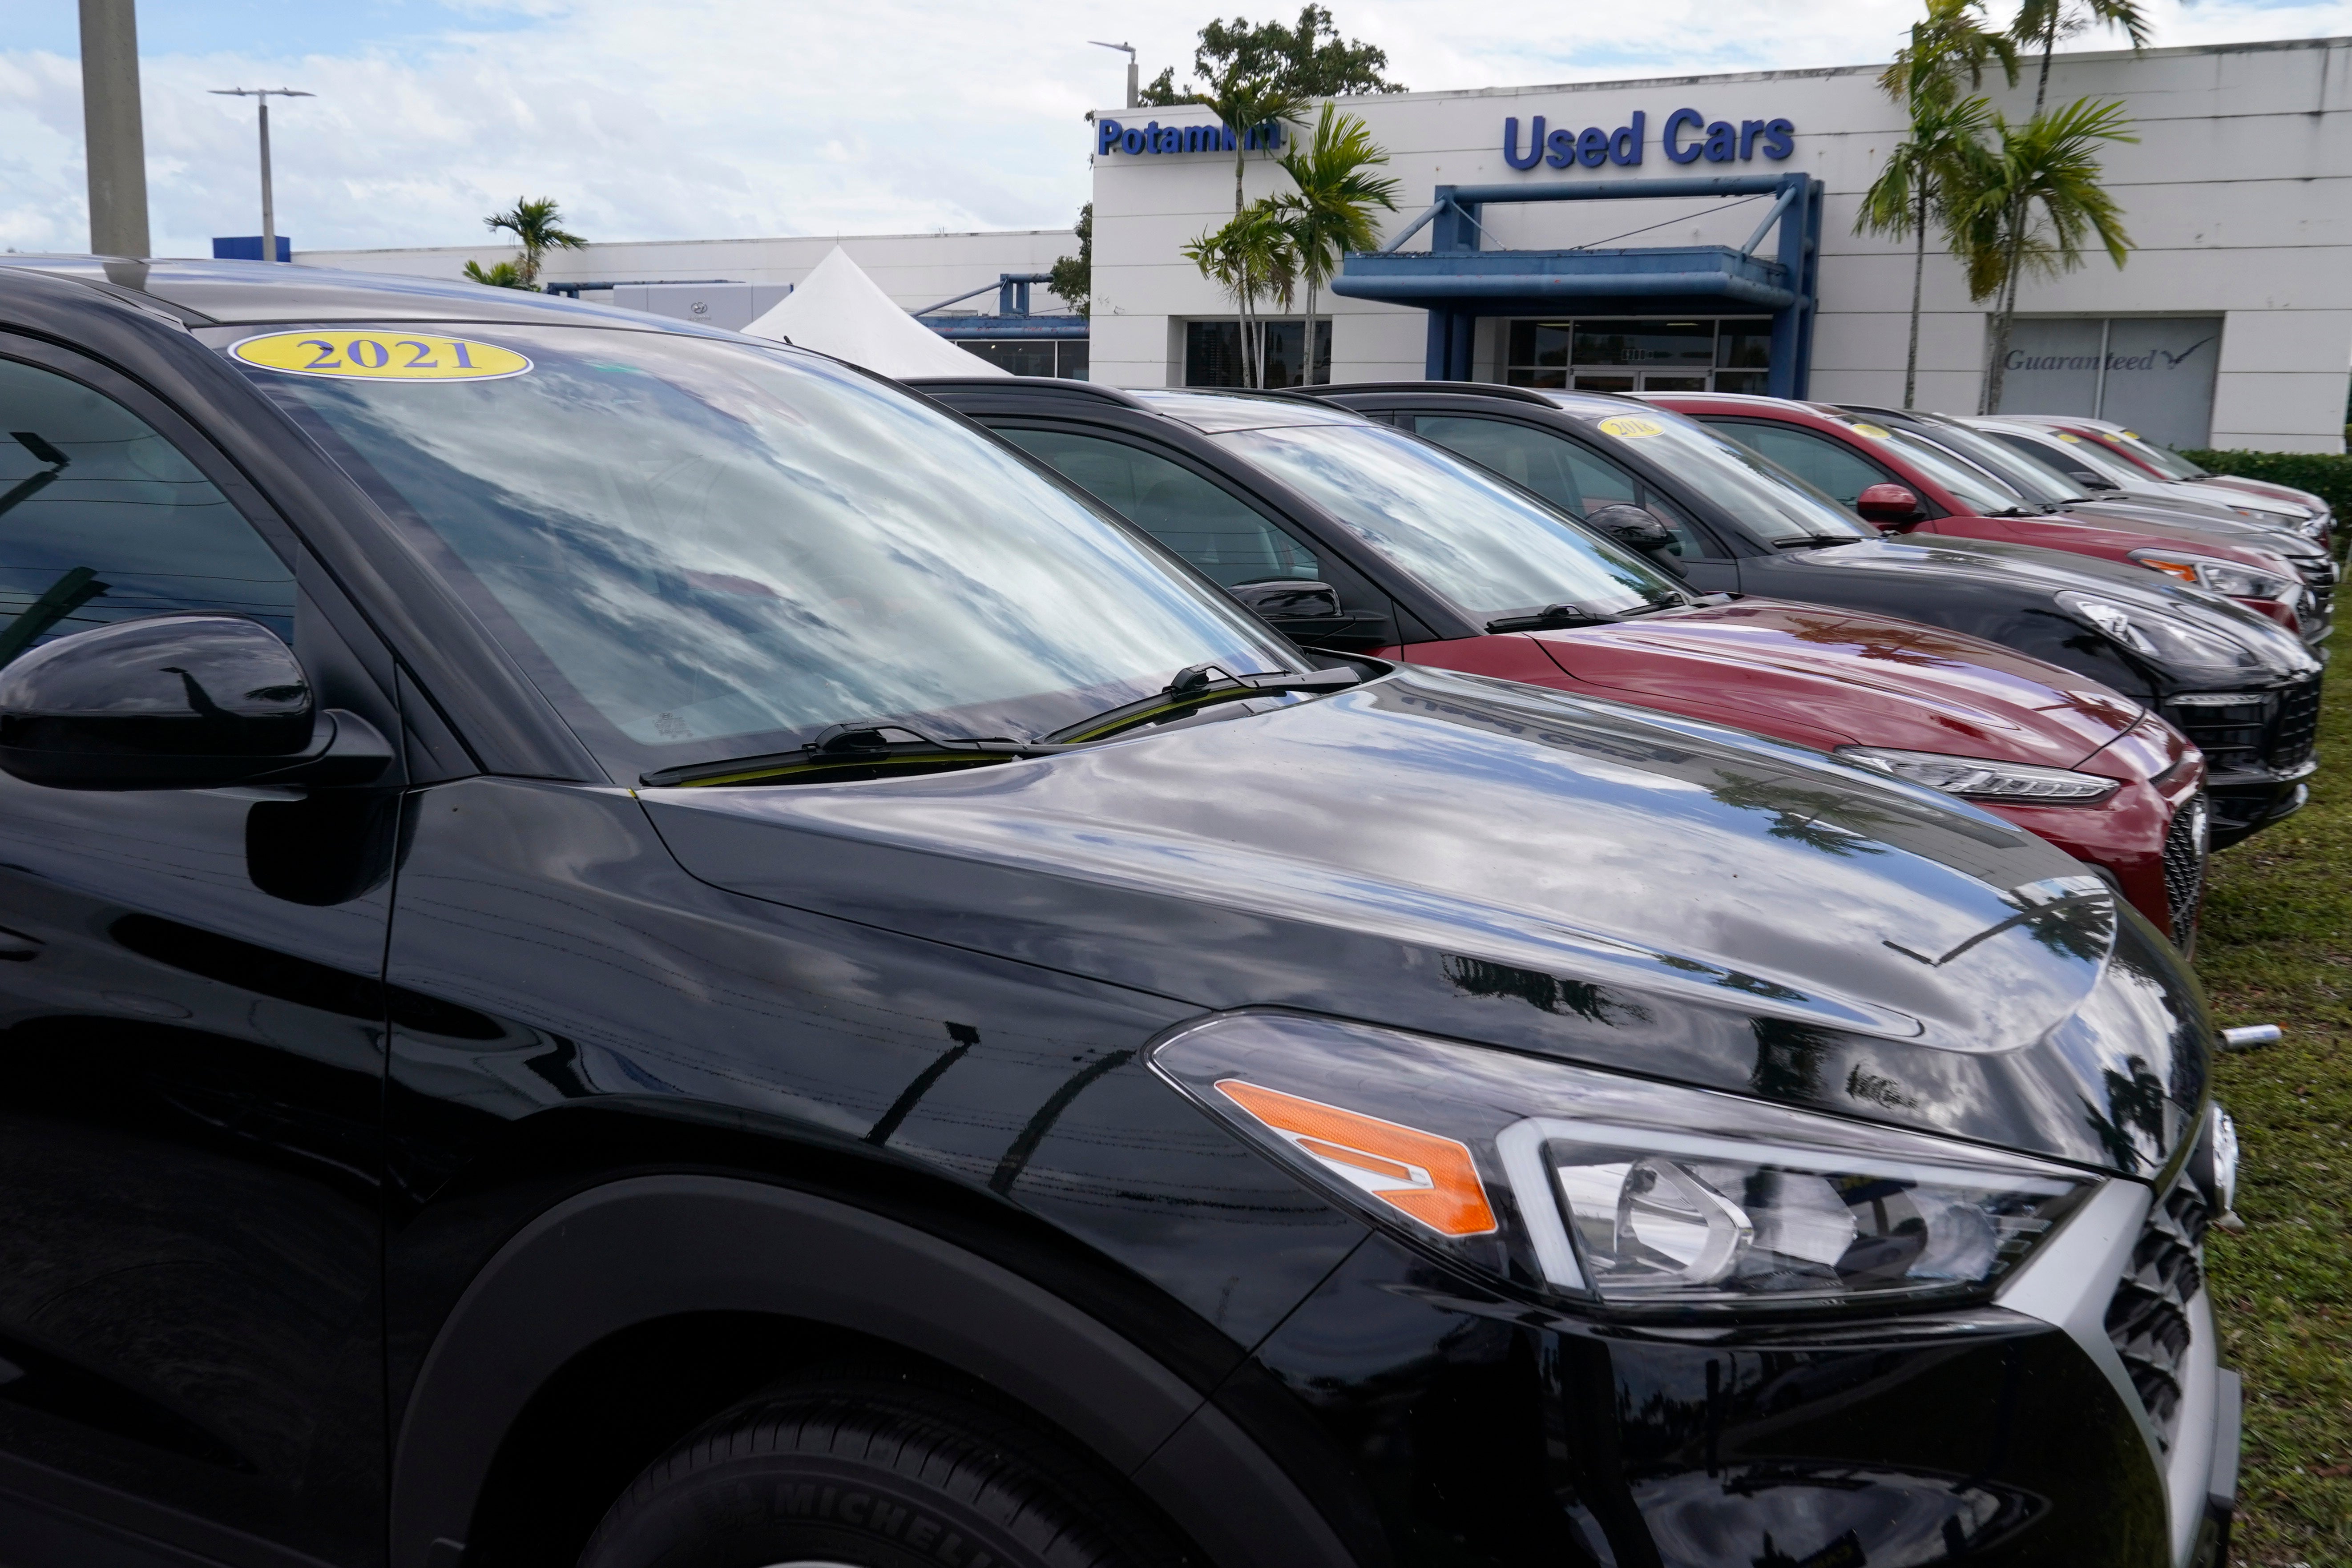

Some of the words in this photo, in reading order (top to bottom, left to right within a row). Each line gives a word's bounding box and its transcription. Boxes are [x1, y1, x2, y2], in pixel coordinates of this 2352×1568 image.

[1504, 110, 1645, 171] Used
[1663, 108, 1794, 164] Cars
[297, 340, 482, 368] 2021
[2005, 350, 2157, 370] Guaranteed
